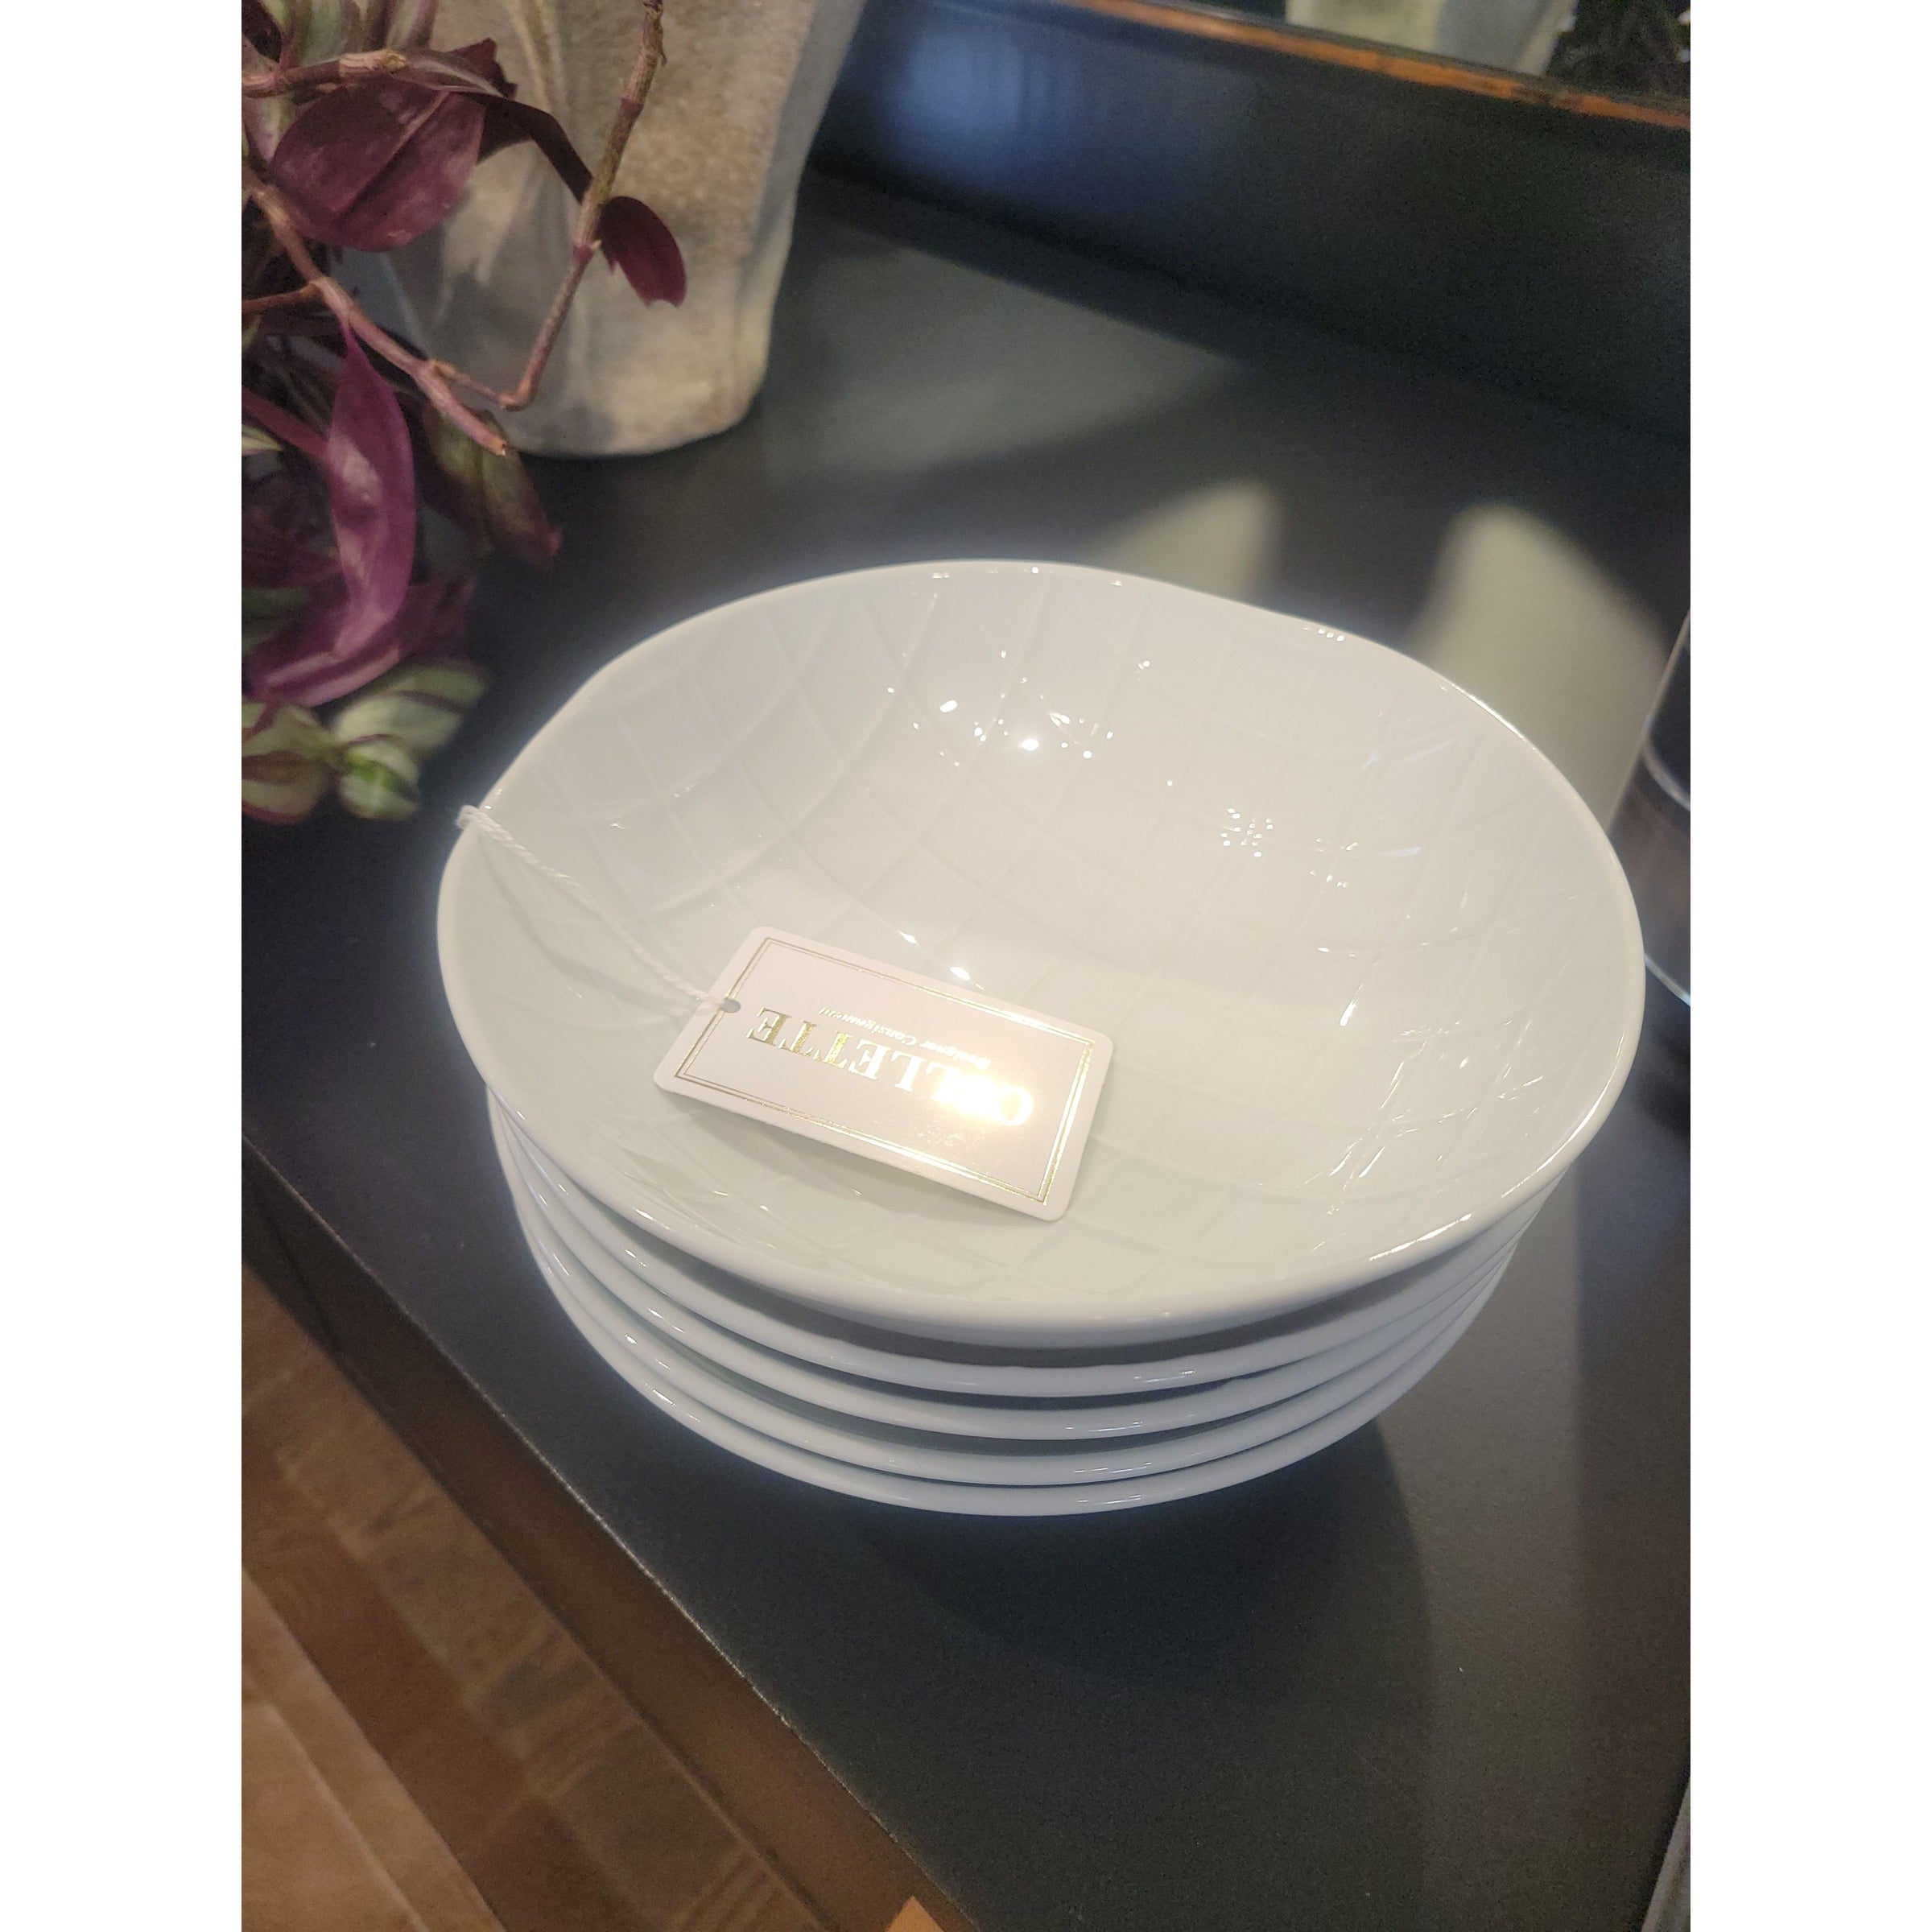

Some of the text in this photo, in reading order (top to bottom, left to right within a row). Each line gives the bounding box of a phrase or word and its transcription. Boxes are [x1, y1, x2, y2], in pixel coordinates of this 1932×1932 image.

[746, 1007, 1034, 1127] CLLETTE
[818, 1007, 991, 1070] Designer Consignment
